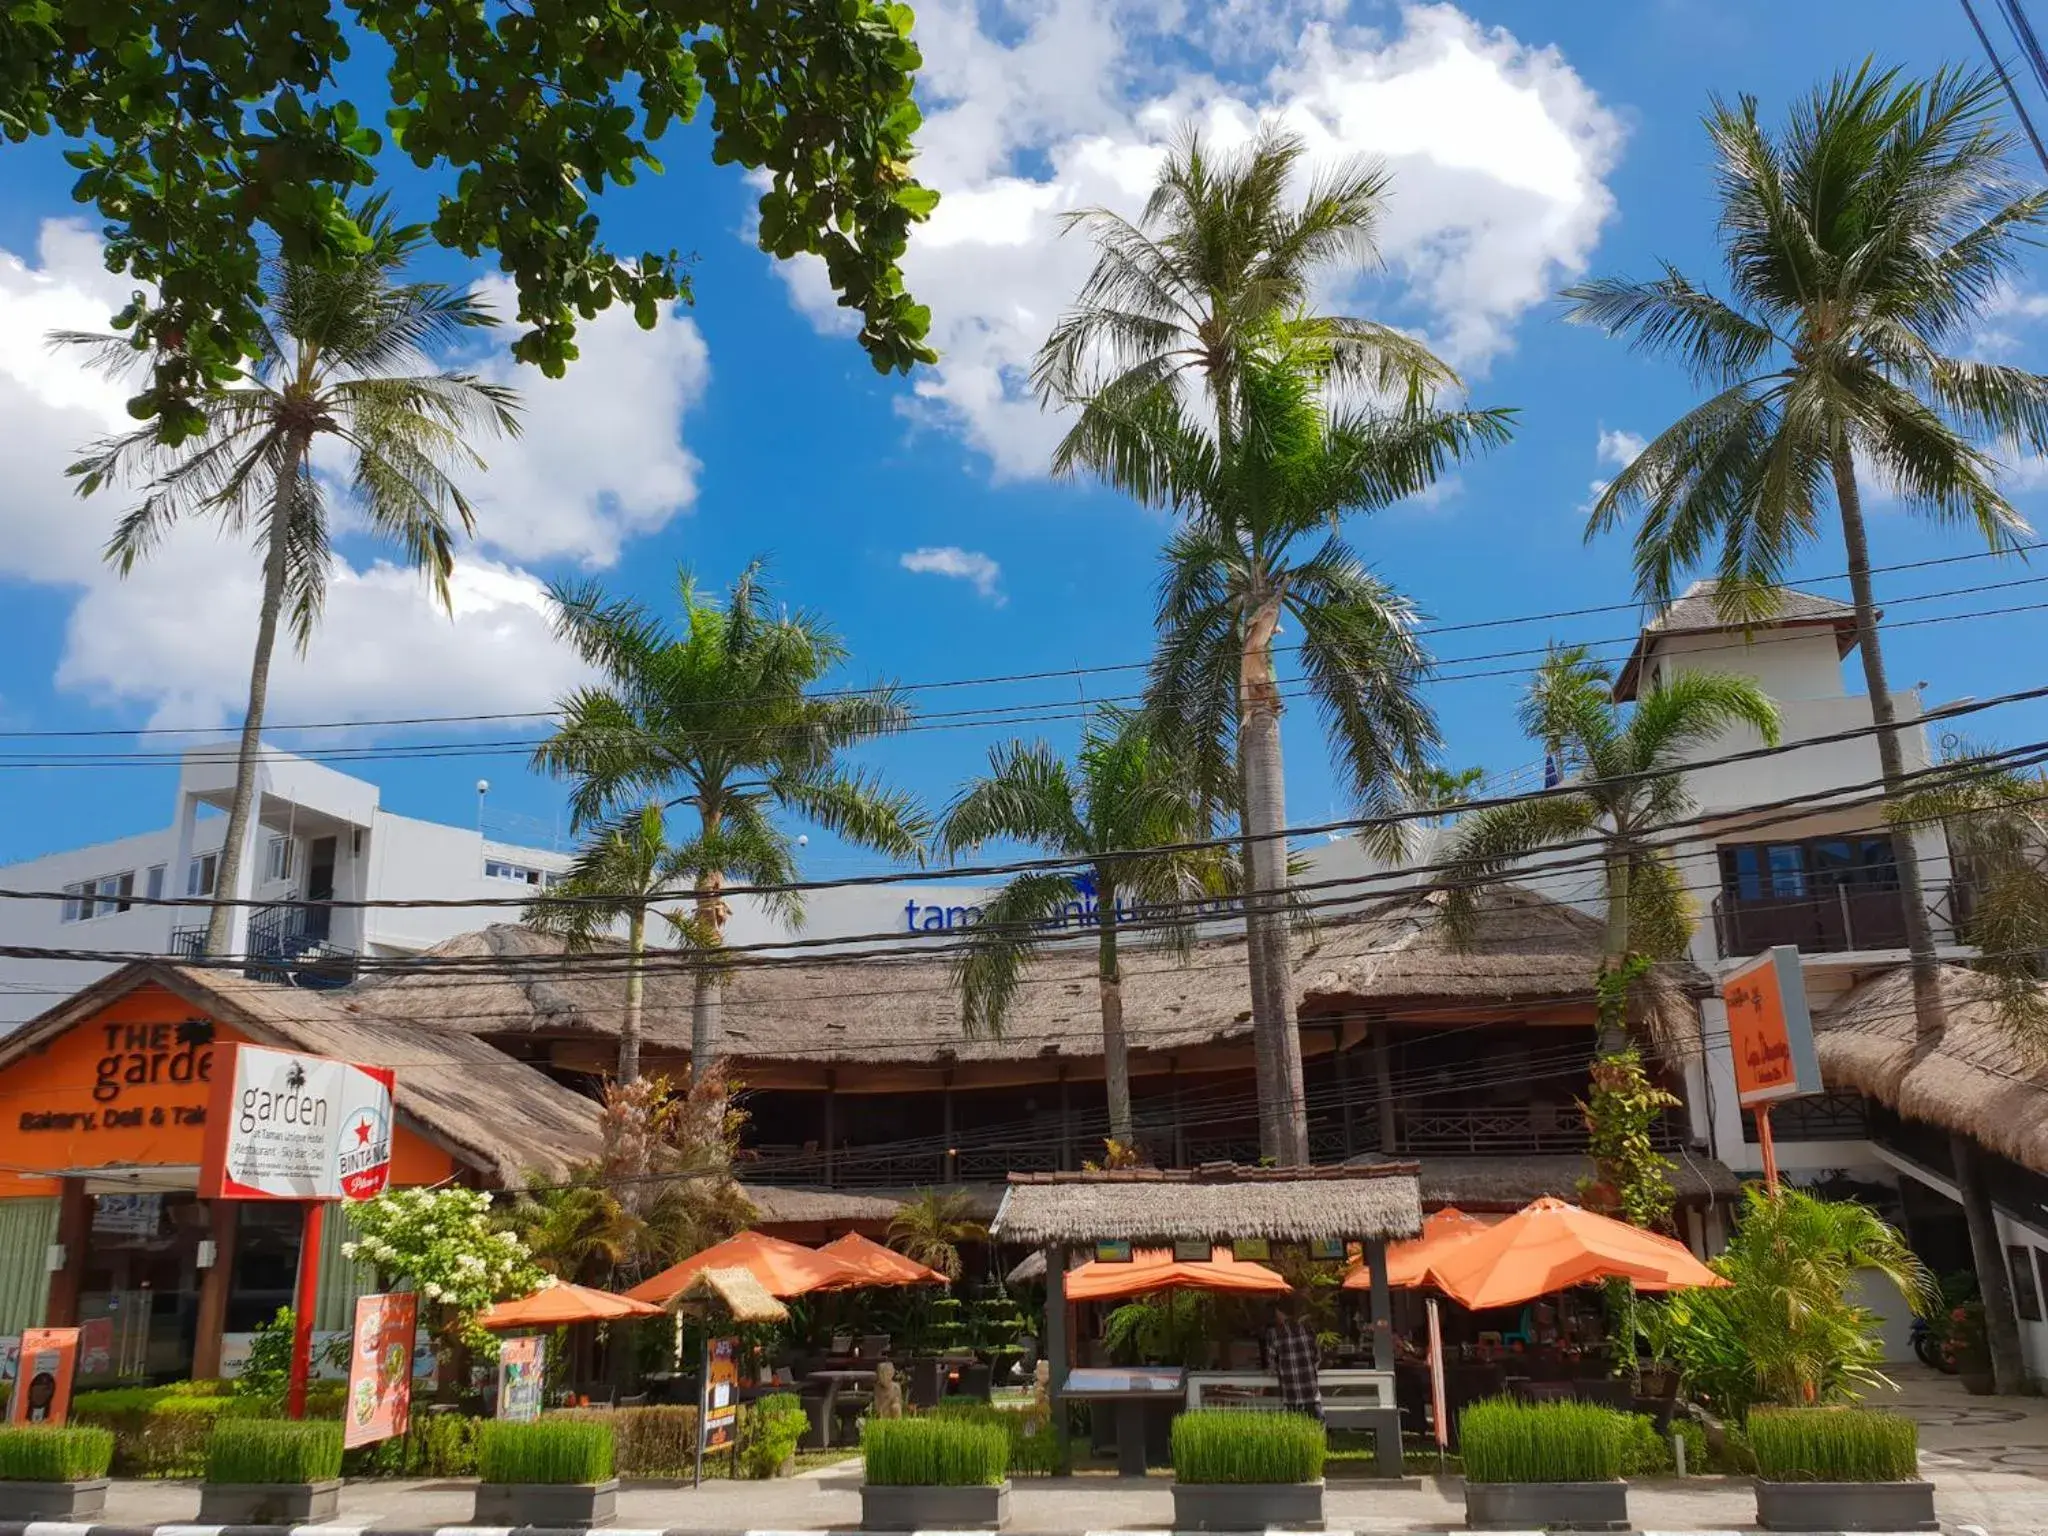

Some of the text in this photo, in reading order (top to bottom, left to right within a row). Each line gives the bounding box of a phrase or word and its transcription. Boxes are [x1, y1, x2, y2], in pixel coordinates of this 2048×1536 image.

[104, 1022, 172, 1051] THE
[93, 1047, 213, 1102] garde
[103, 1107, 144, 1129] Deli
[149, 1106, 165, 1126] &
[171, 1105, 207, 1125] Tak
[239, 1087, 328, 1134] garden
[340, 1143, 389, 1175] BINTANG
